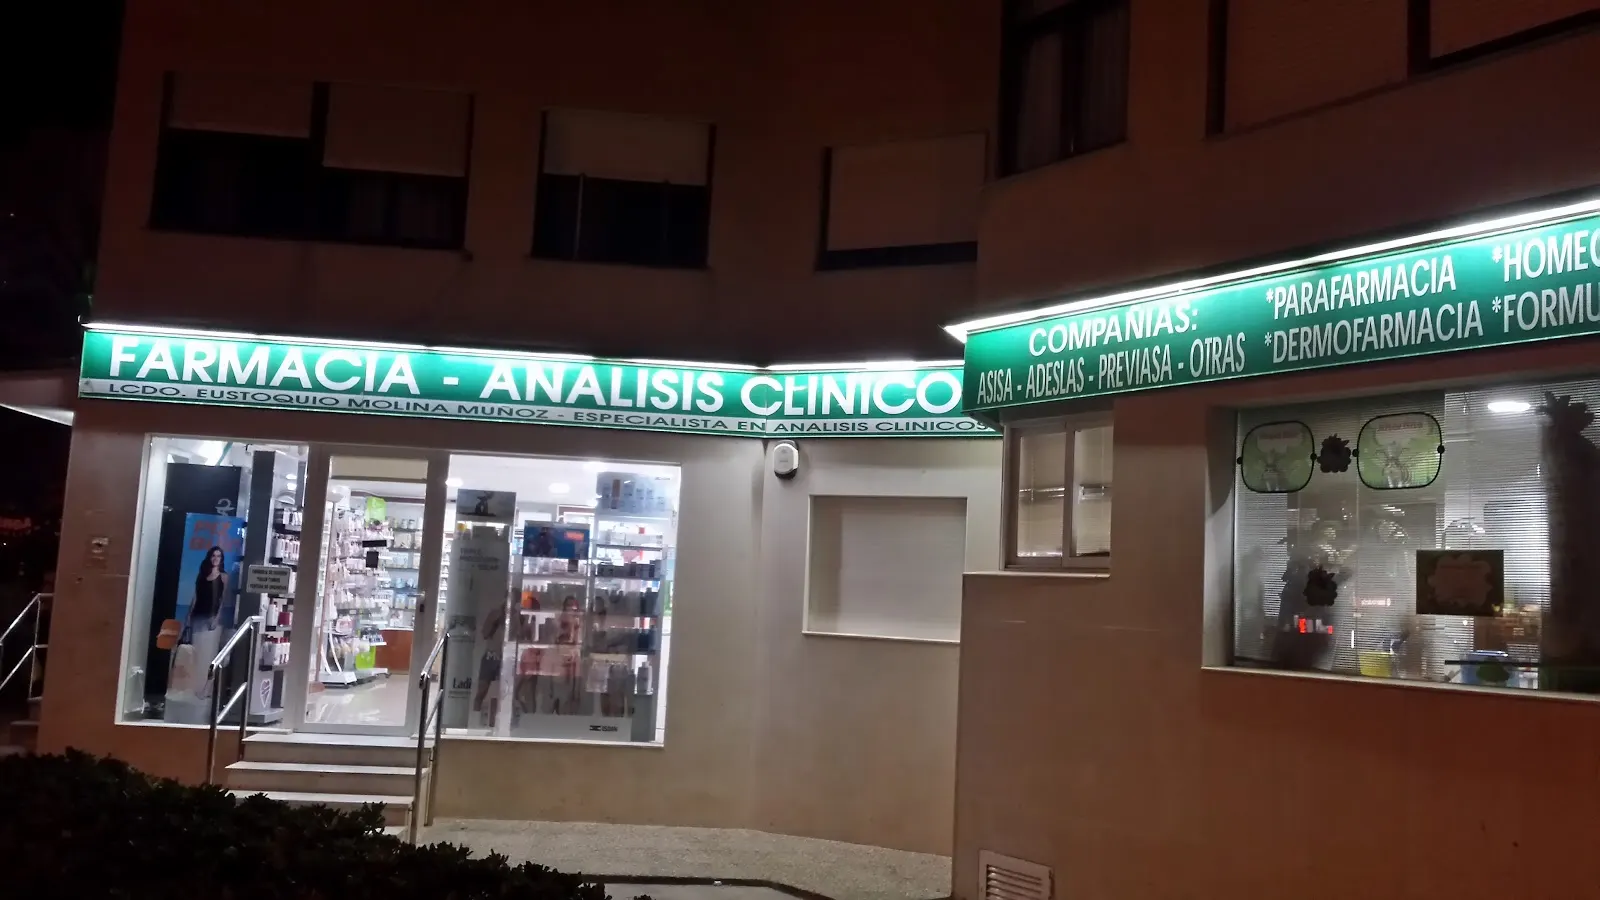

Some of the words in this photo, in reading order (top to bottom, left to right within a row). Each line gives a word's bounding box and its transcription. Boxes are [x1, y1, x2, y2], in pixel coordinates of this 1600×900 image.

[109, 335, 421, 395] FARMACIA
[479, 361, 725, 413] ANALISIS
[740, 370, 963, 416] CLINICO
[977, 368, 1013, 404] ASISA
[1025, 356, 1085, 399] ADESLAS
[1098, 343, 1173, 389] PREVIASA
[1190, 331, 1246, 378] OTRAS
[109, 383, 187, 398] LCDO.
[197, 388, 340, 406] EUSTOQUIO
[348, 398, 448, 413] MOLINA
[457, 402, 549, 419] MUÑOZ
[573, 411, 729, 430] ESPECIALISTA
[737, 421, 766, 431] EN
[774, 422, 869, 432] ANALISIS
